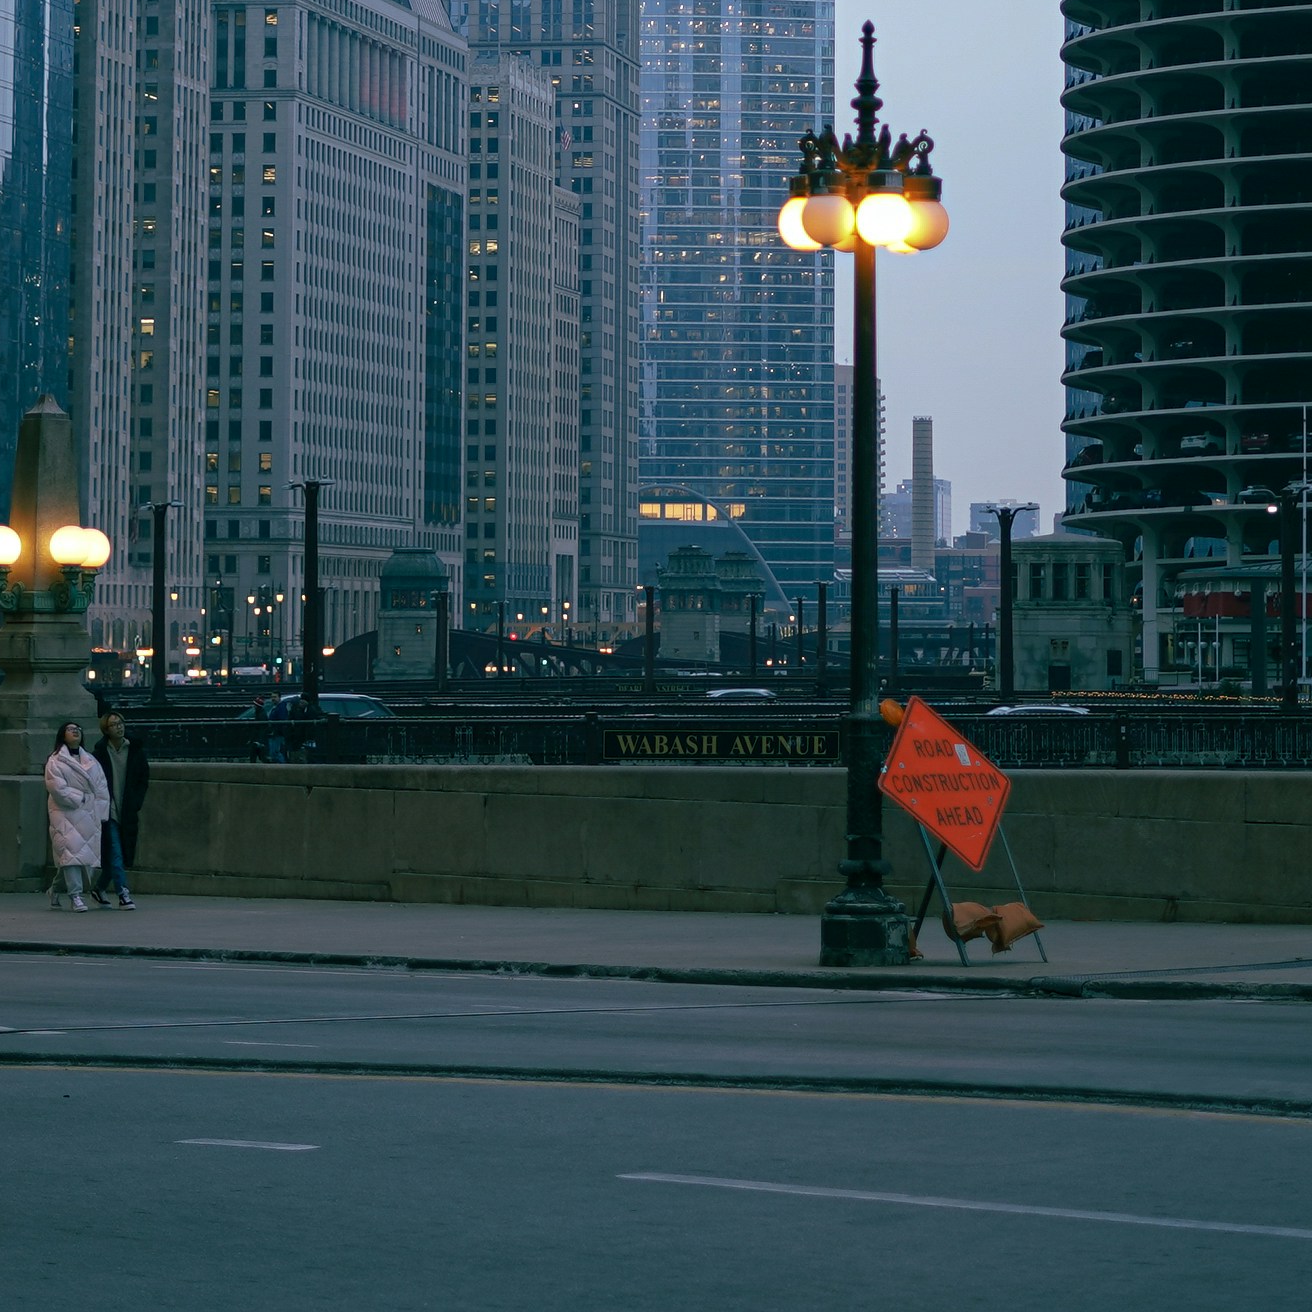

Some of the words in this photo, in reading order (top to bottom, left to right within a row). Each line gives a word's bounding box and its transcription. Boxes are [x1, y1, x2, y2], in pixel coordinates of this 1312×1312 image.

[616, 734, 719, 756] WABASH
[729, 735, 827, 756] AVENUE
[913, 739, 954, 758] ROAD
[891, 771, 1001, 794] CONSTRUCTION
[936, 806, 983, 826] AHEAD
